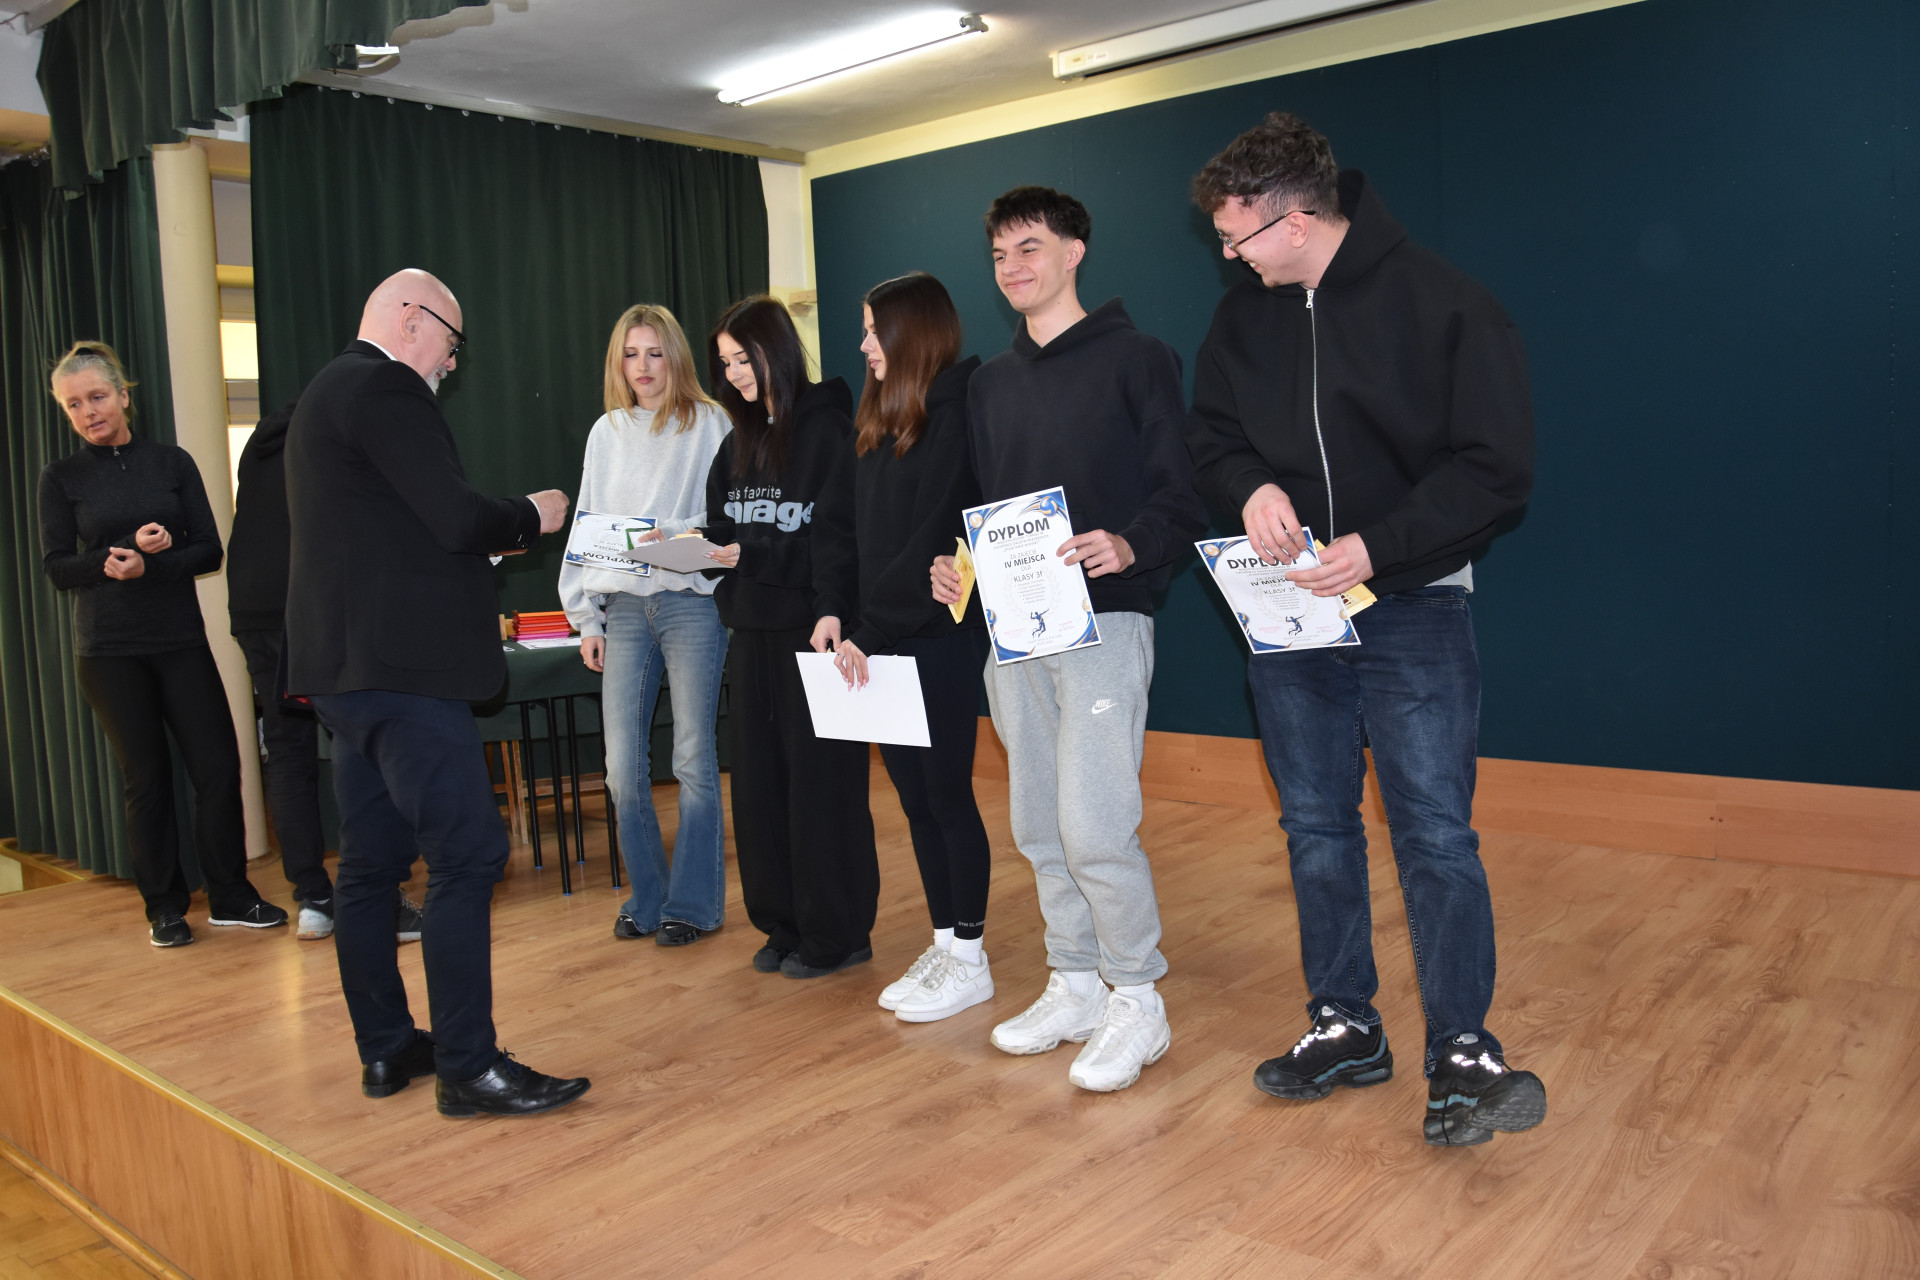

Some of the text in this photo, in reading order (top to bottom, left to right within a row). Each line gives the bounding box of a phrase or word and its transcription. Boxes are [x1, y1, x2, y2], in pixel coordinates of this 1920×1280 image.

[988, 517, 1050, 543] DYPLOM
[583, 551, 634, 565] DYPLOM
[1004, 553, 1046, 568] IV MIEJSCA
[1227, 557, 1297, 569] DYPL
[1013, 572, 1034, 583] KLASY
[1261, 577, 1288, 586] MIEJS
[1095, 698, 1111, 708] NIKE
